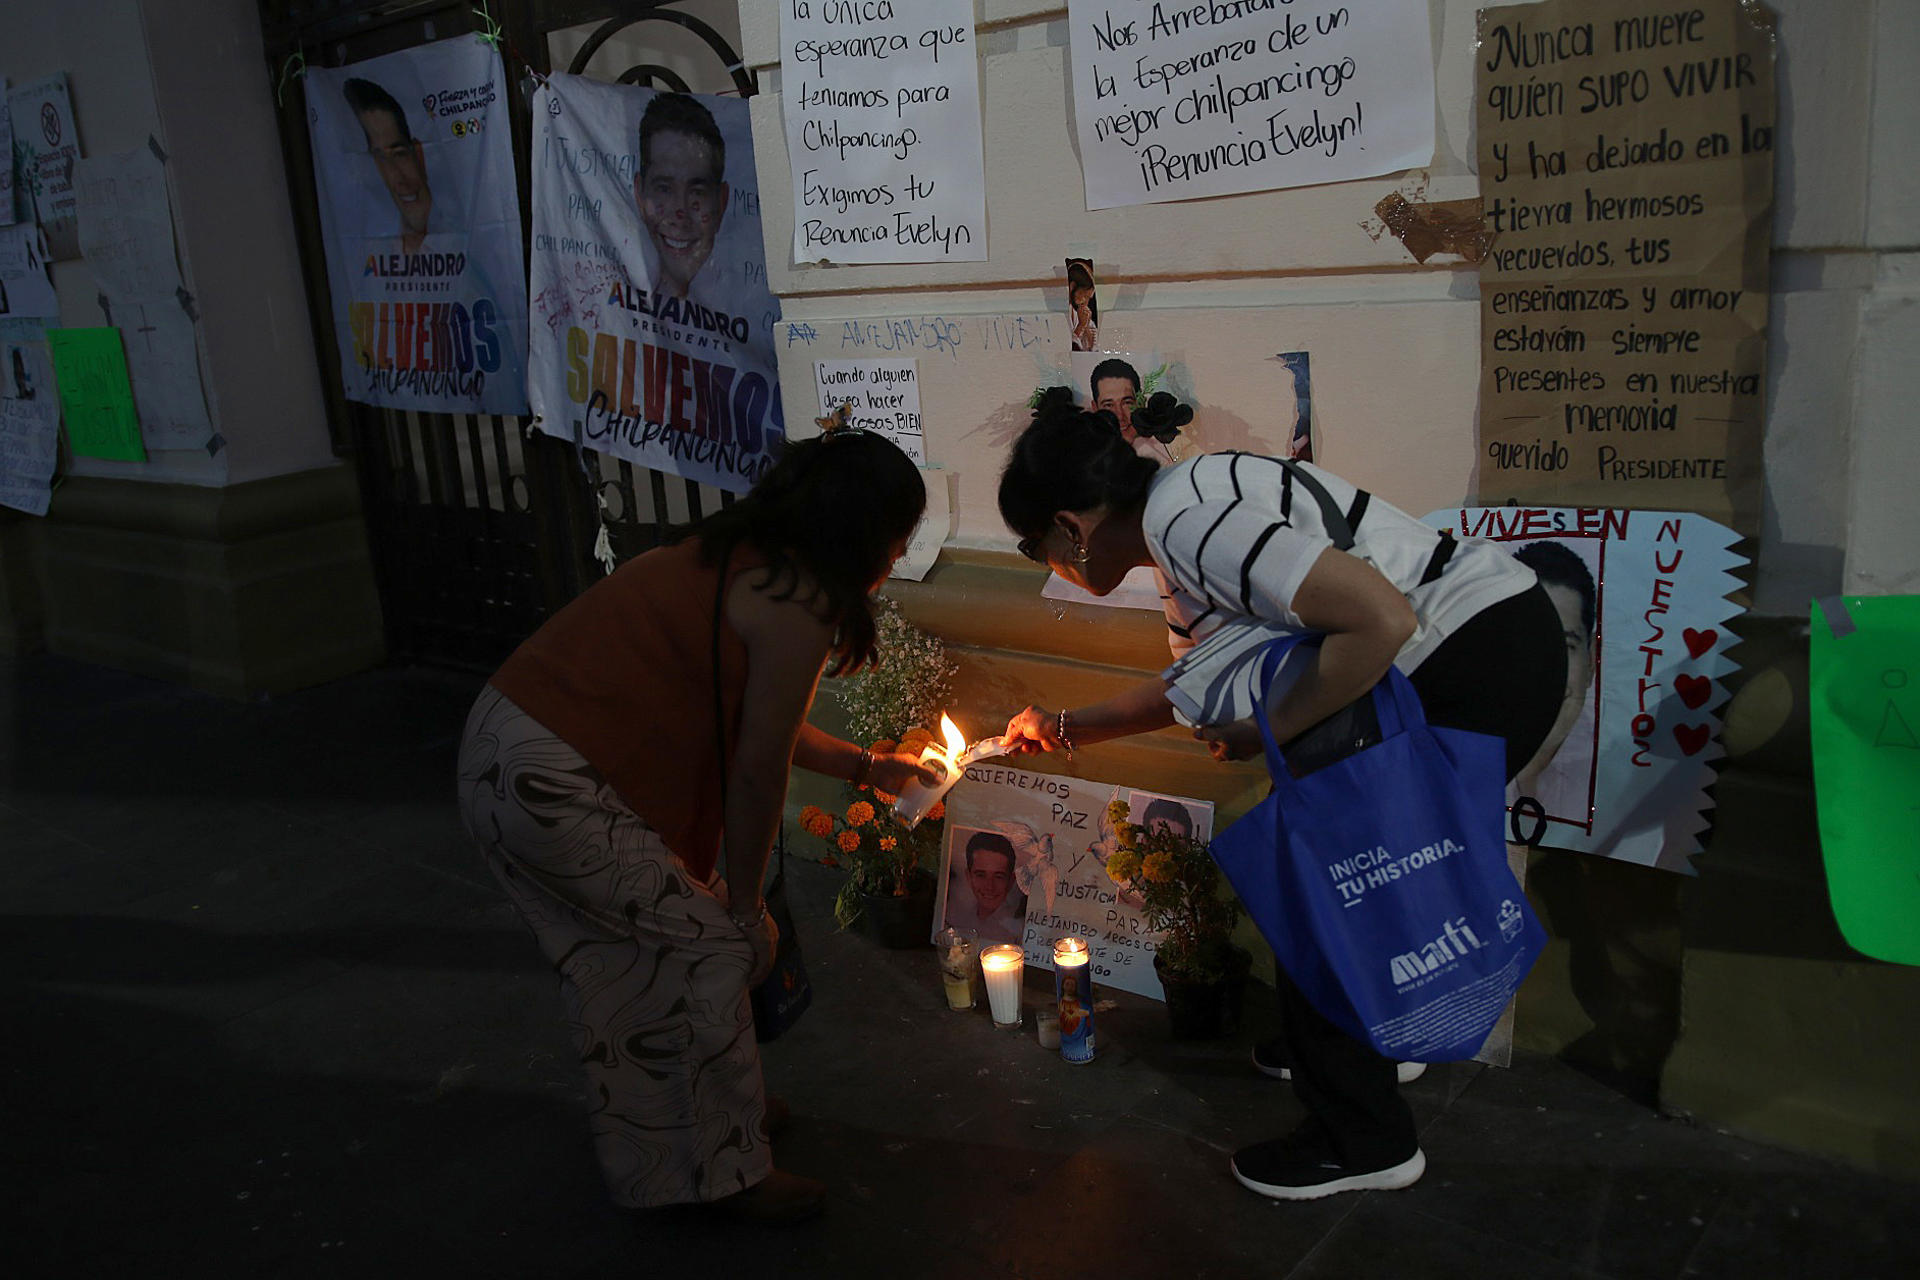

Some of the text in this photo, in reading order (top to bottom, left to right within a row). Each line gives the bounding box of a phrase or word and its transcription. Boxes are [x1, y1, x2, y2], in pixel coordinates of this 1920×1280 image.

[795, 26, 965, 78] esperanza que
[1093, 6, 1349, 100] la Esperanza de un
[1487, 9, 1704, 72] Nunca muere
[1579, 69, 1648, 114] SUPO
[1663, 53, 1756, 98] VIVIR
[898, 86, 949, 118] para
[803, 120, 921, 160] Chilpancingo.
[1095, 104, 1166, 147] mejor
[1134, 102, 1365, 192] ¡Renuncia Evelyn!
[1528, 141, 1566, 179] ha
[1586, 128, 1684, 173] dejado
[1696, 132, 1729, 159] en
[1741, 113, 1773, 154] la
[803, 169, 935, 214] Exigimos tu
[1487, 188, 1704, 233] tierra hermosos
[803, 211, 971, 254] Renuncia Evelyn
[364, 251, 466, 279] ALEJANDRO
[385, 281, 450, 293] PRESIDENTE
[1493, 285, 1629, 314] enseñanzas
[1670, 287, 1744, 311] amor
[608, 282, 750, 344] ALEJANDRO
[632, 319, 731, 354] PRESIDENTE
[1494, 324, 1700, 355] estarán siempre
[819, 363, 914, 391] Cuando alguien
[1494, 366, 1760, 395] Presentes en nuestra
[866, 390, 904, 410] hacer
[1565, 398, 1678, 434] memoria
[894, 412, 922, 432] BIEN
[1488, 438, 1569, 472] querido
[1577, 509, 1630, 540] EN
[964, 766, 1070, 800] QUEREMOS
[1051, 802, 1088, 830] PAZ
[1328, 845, 1392, 882] INICIA
[1336, 876, 1366, 900] TU
[1026, 911, 1098, 937] ALEJANDRO
[1113, 951, 1134, 966] DE
